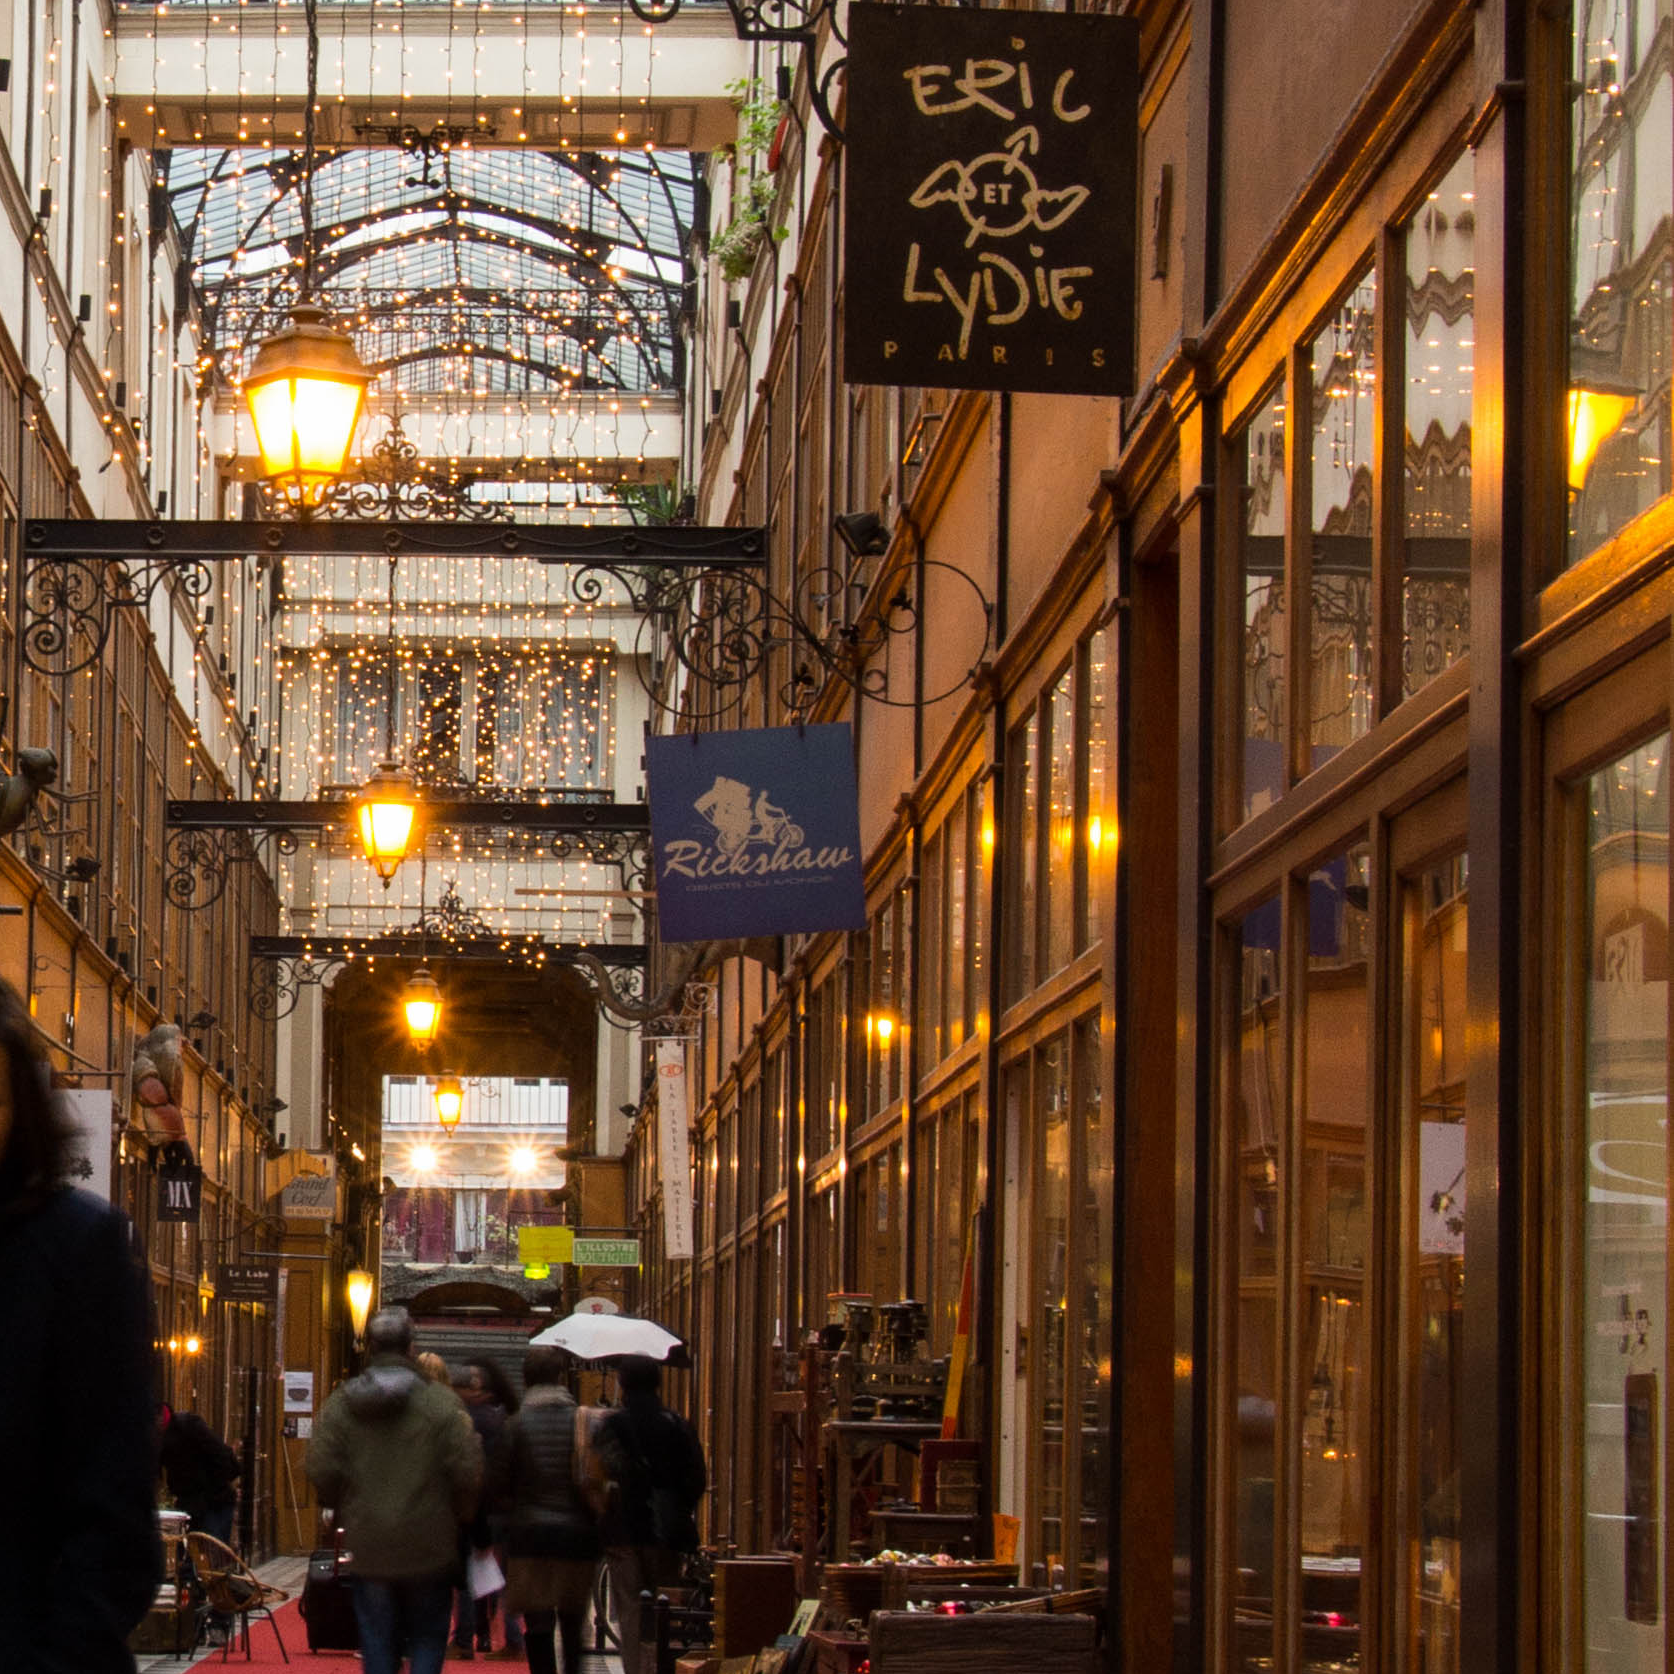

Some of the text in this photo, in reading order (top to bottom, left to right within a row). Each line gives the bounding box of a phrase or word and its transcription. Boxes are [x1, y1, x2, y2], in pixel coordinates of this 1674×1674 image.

[983, 183, 1012, 205] ET
[883, 340, 1106, 367] PARIS
[662, 837, 855, 878] Rickshaw
[166, 1180, 193, 1209] MX
